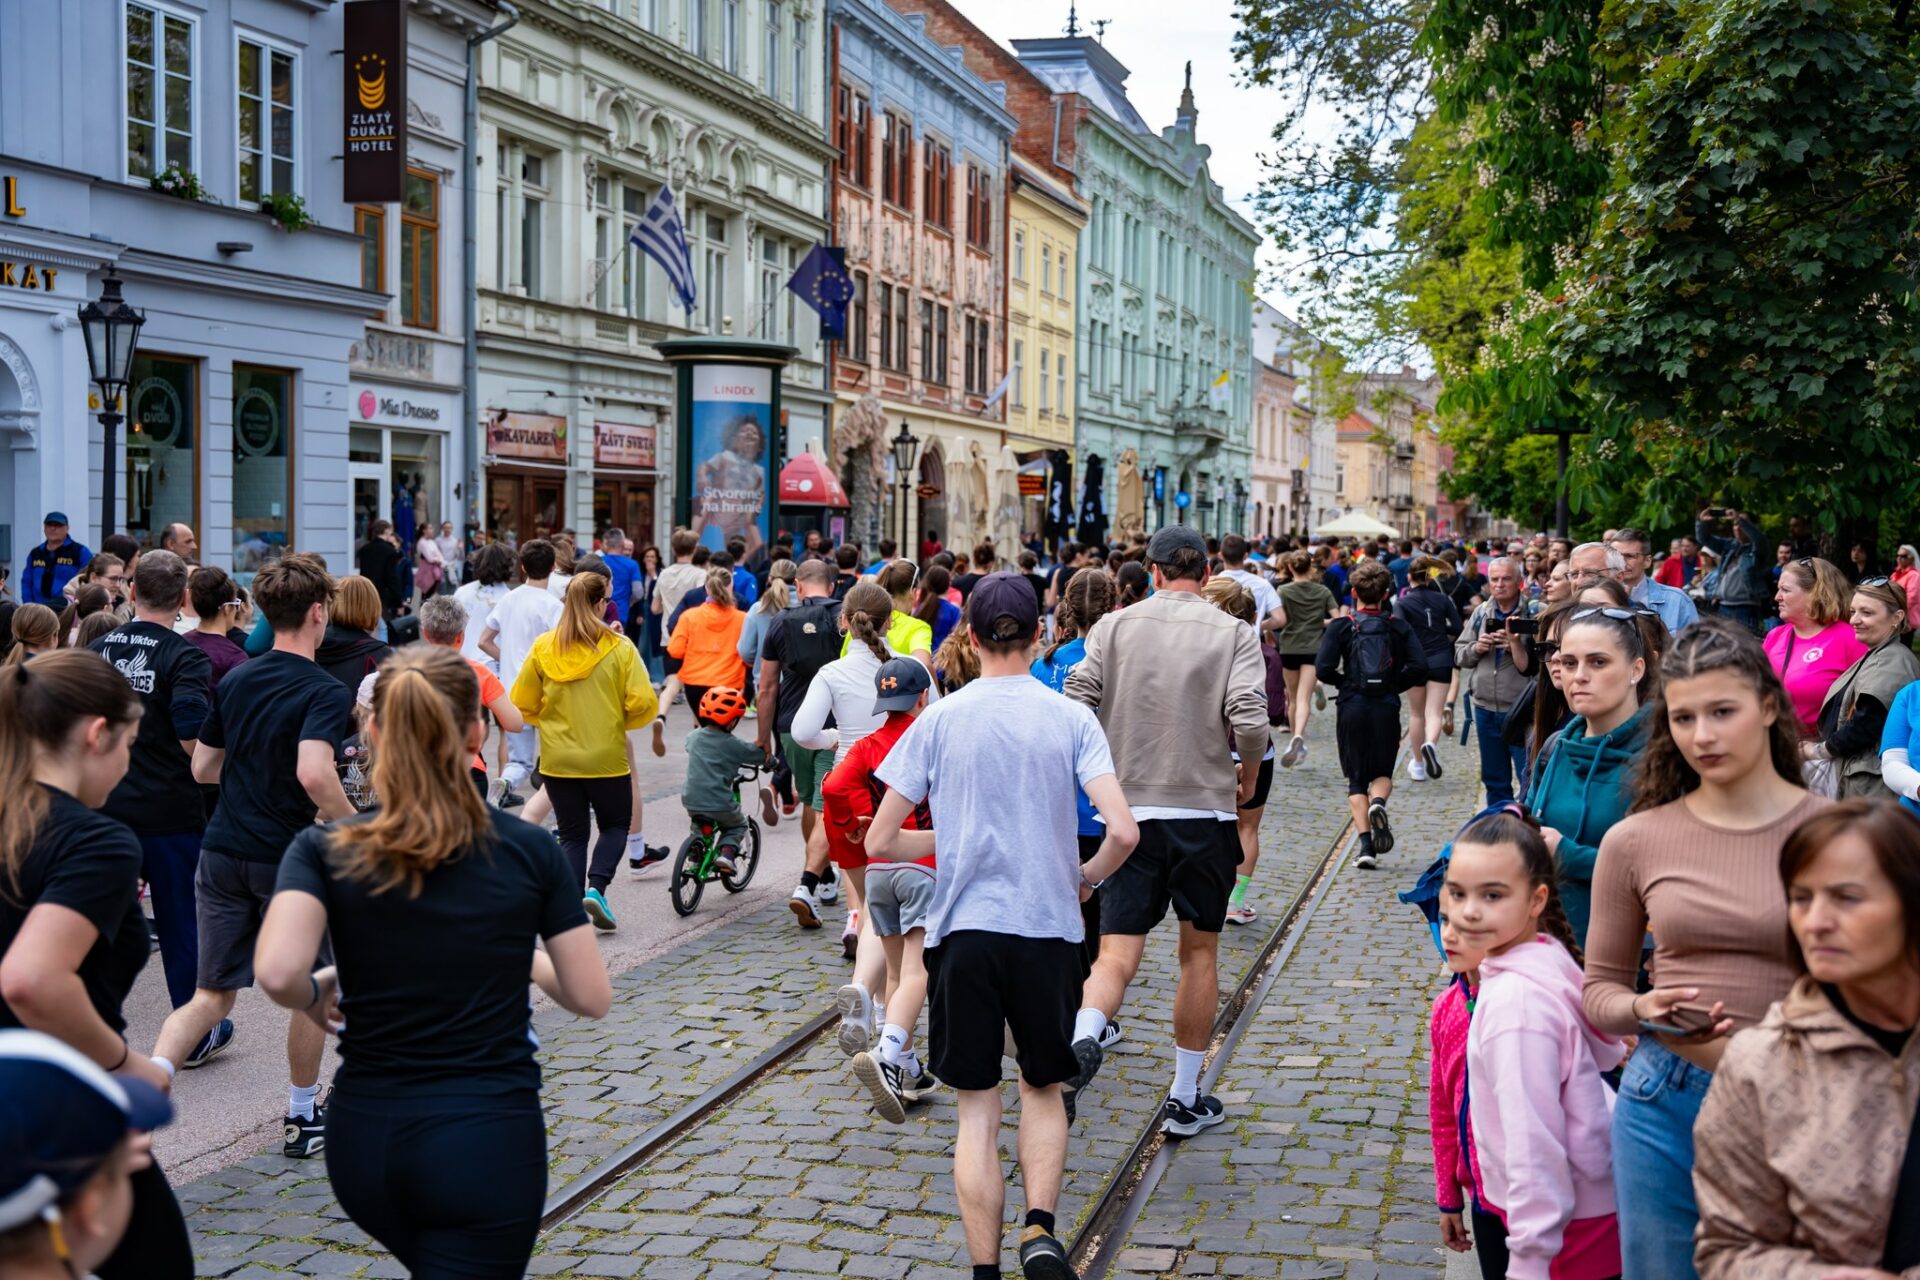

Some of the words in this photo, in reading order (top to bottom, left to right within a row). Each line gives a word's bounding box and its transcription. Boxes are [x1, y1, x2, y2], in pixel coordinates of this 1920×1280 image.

[351, 110, 391, 125] ZLATÝ
[350, 123, 394, 137] DUKÁT
[351, 141, 393, 152] HOTEL
[713, 384, 756, 396] LINDEX
[380, 398, 399, 416] Mia
[402, 401, 440, 421] Dresses
[702, 502, 719, 512] na
[130, 634, 159, 648] Viktor
